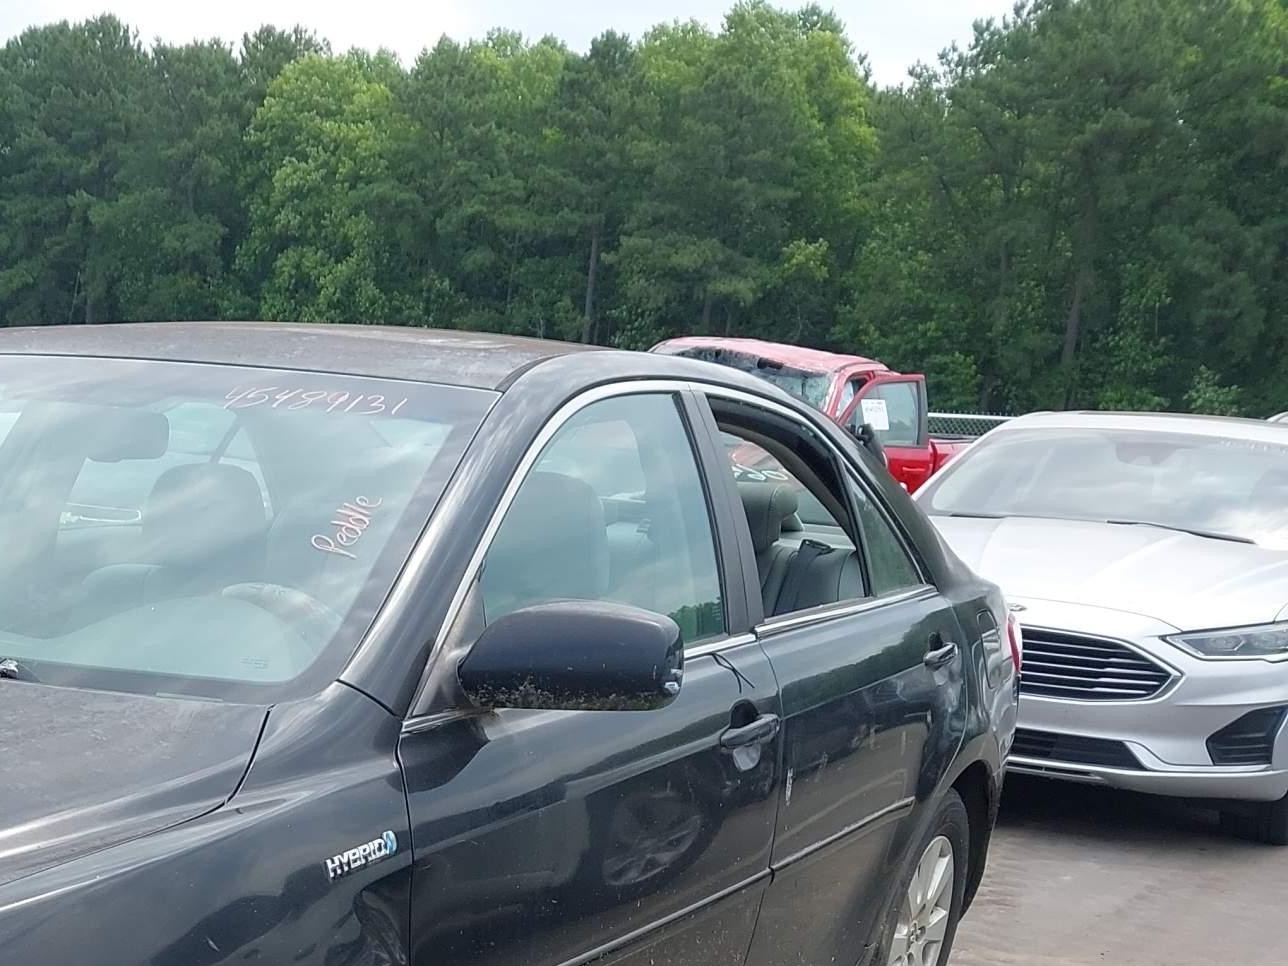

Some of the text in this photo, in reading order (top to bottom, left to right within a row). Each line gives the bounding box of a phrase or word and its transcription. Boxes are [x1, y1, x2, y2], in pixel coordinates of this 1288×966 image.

[223, 386, 408, 415] 45489131
[311, 495, 383, 559] Peddle
[325, 838, 388, 878] HYBRID
